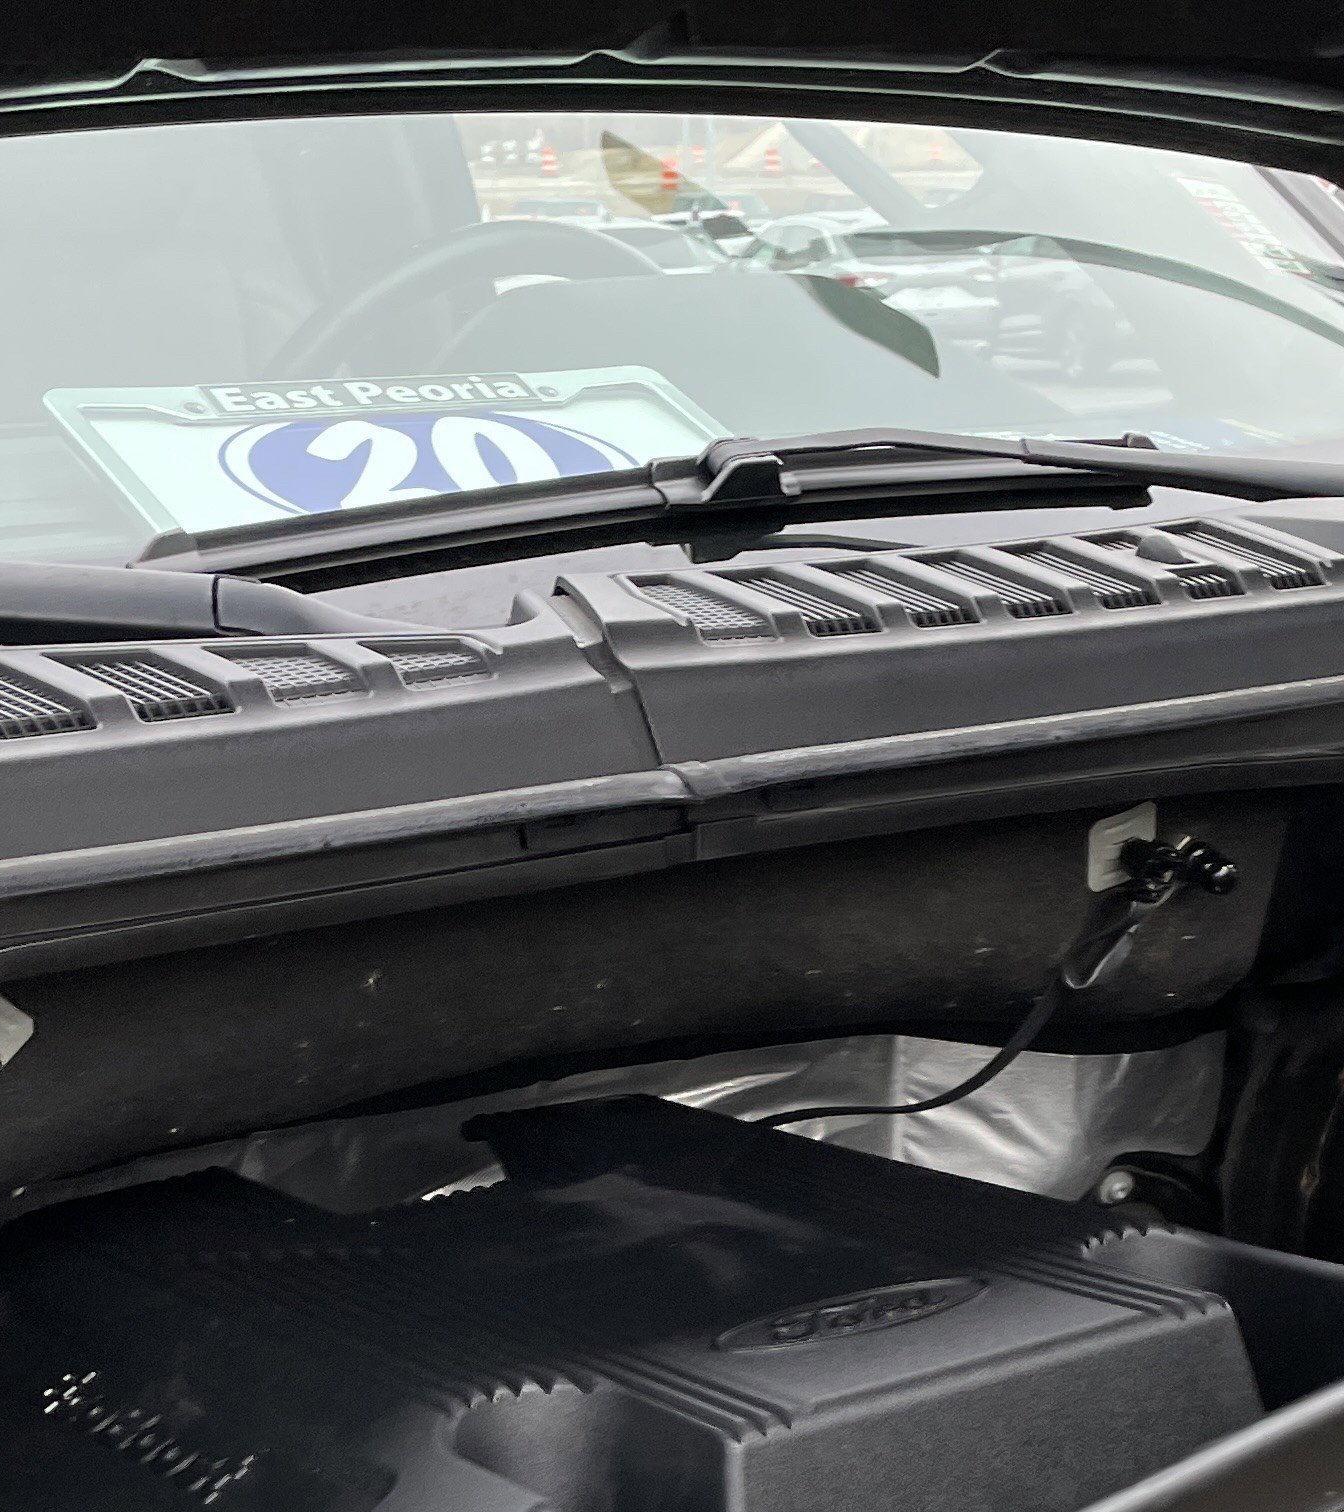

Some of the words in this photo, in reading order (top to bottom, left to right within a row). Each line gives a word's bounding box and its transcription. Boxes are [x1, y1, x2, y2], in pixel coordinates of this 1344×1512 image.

[210, 385, 335, 412] East
[344, 376, 530, 406] Peoria
[306, 416, 561, 510] 20
